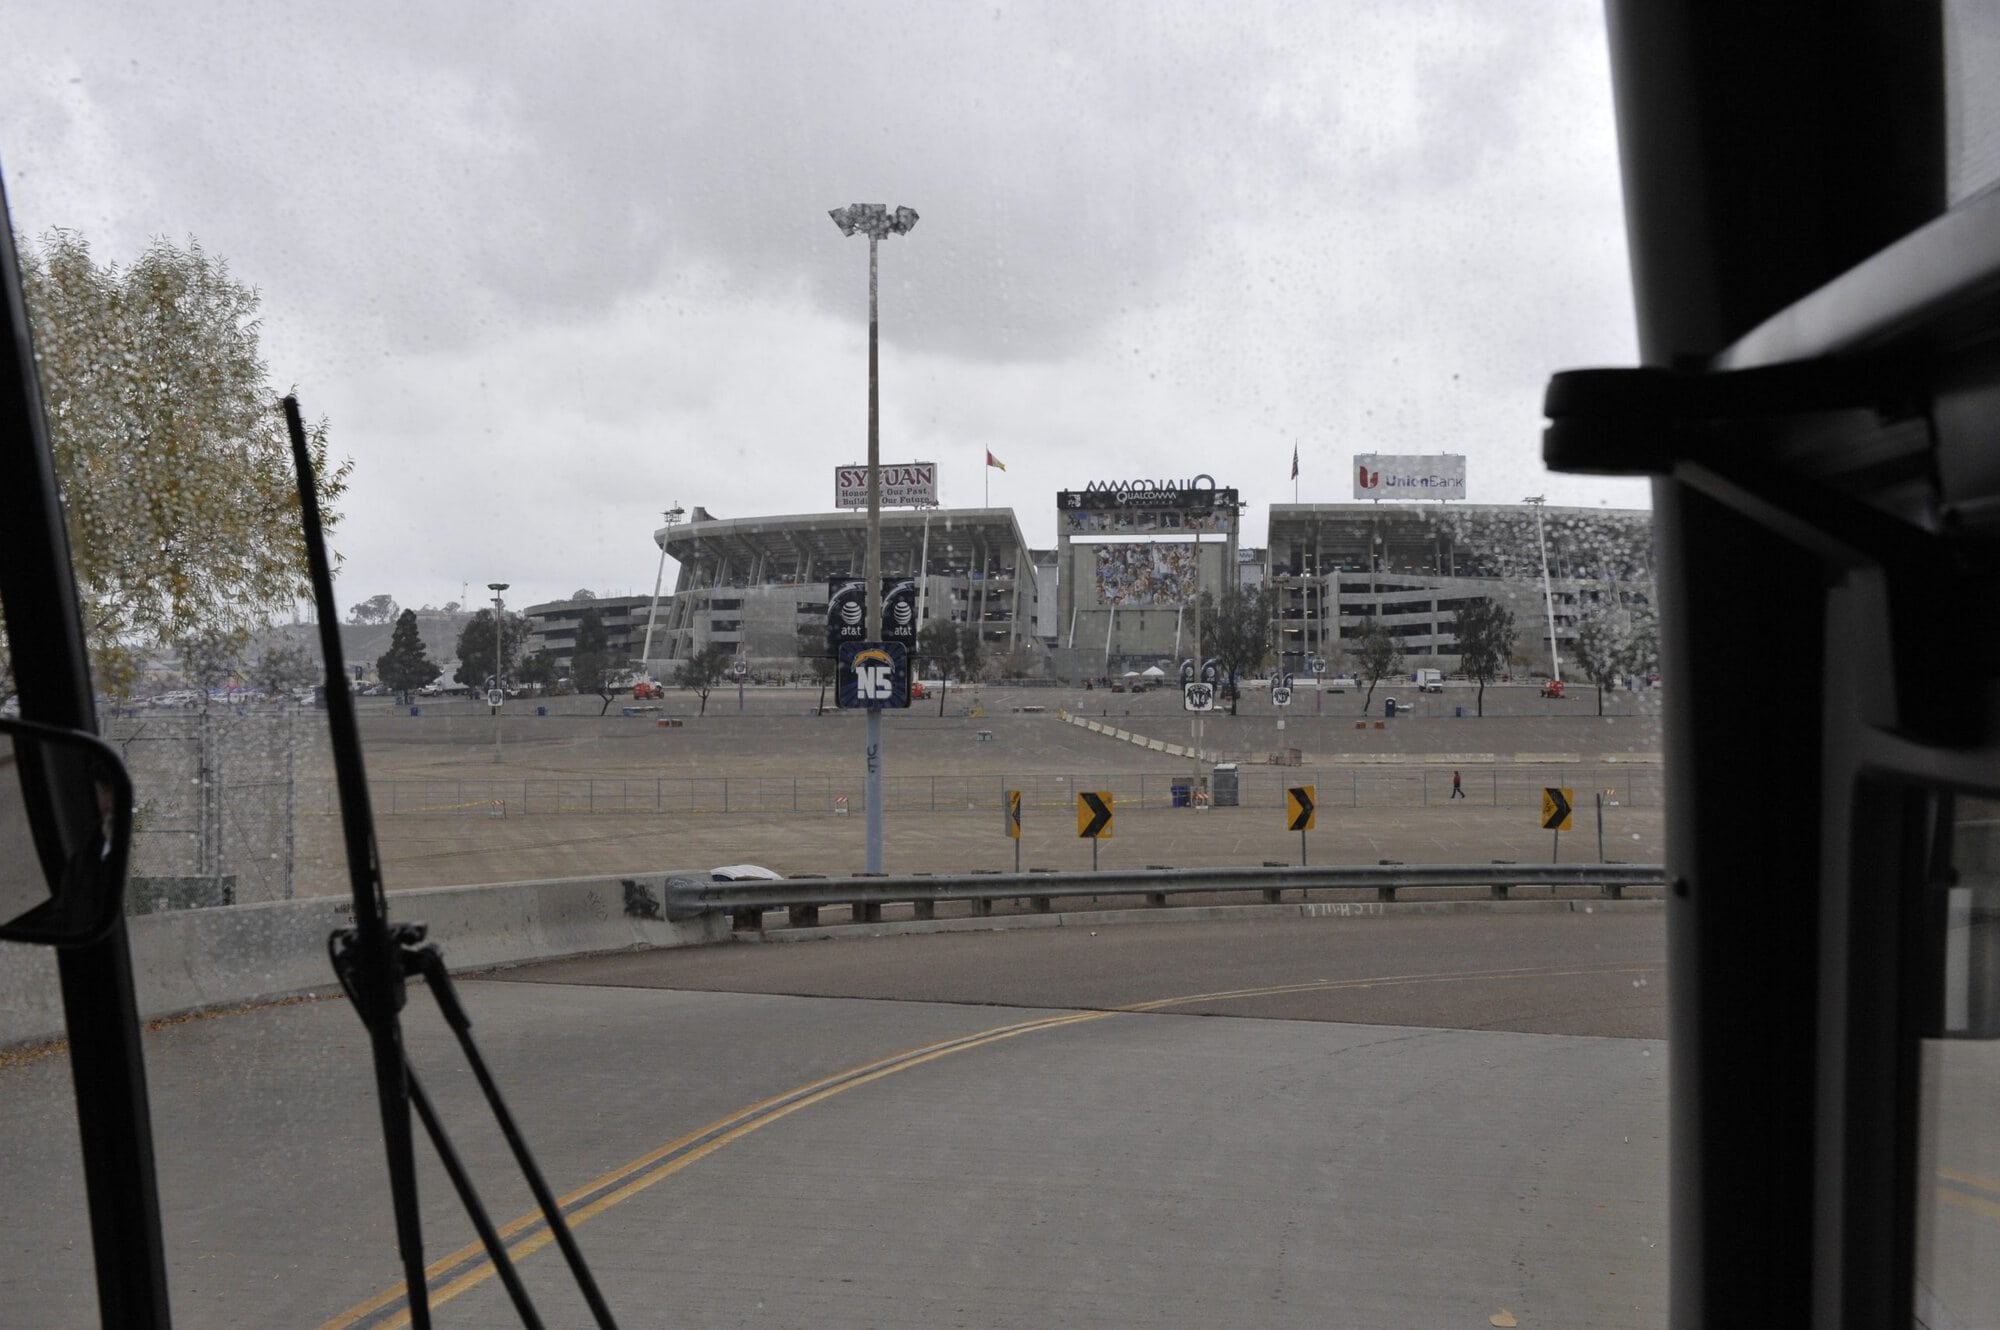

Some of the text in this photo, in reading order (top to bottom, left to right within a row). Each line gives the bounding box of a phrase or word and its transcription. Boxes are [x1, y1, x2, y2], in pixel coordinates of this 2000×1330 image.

[841, 467, 932, 487] SYUAN
[842, 488, 884, 498] Honor
[887, 488, 903, 496] Our
[1116, 490, 1177, 504] QUALCOMM
[881, 496, 898, 505] Our
[841, 626, 861, 636] at&t
[894, 626, 912, 636] at&t
[856, 666, 893, 699] N5
[1193, 693, 1205, 705] N4
